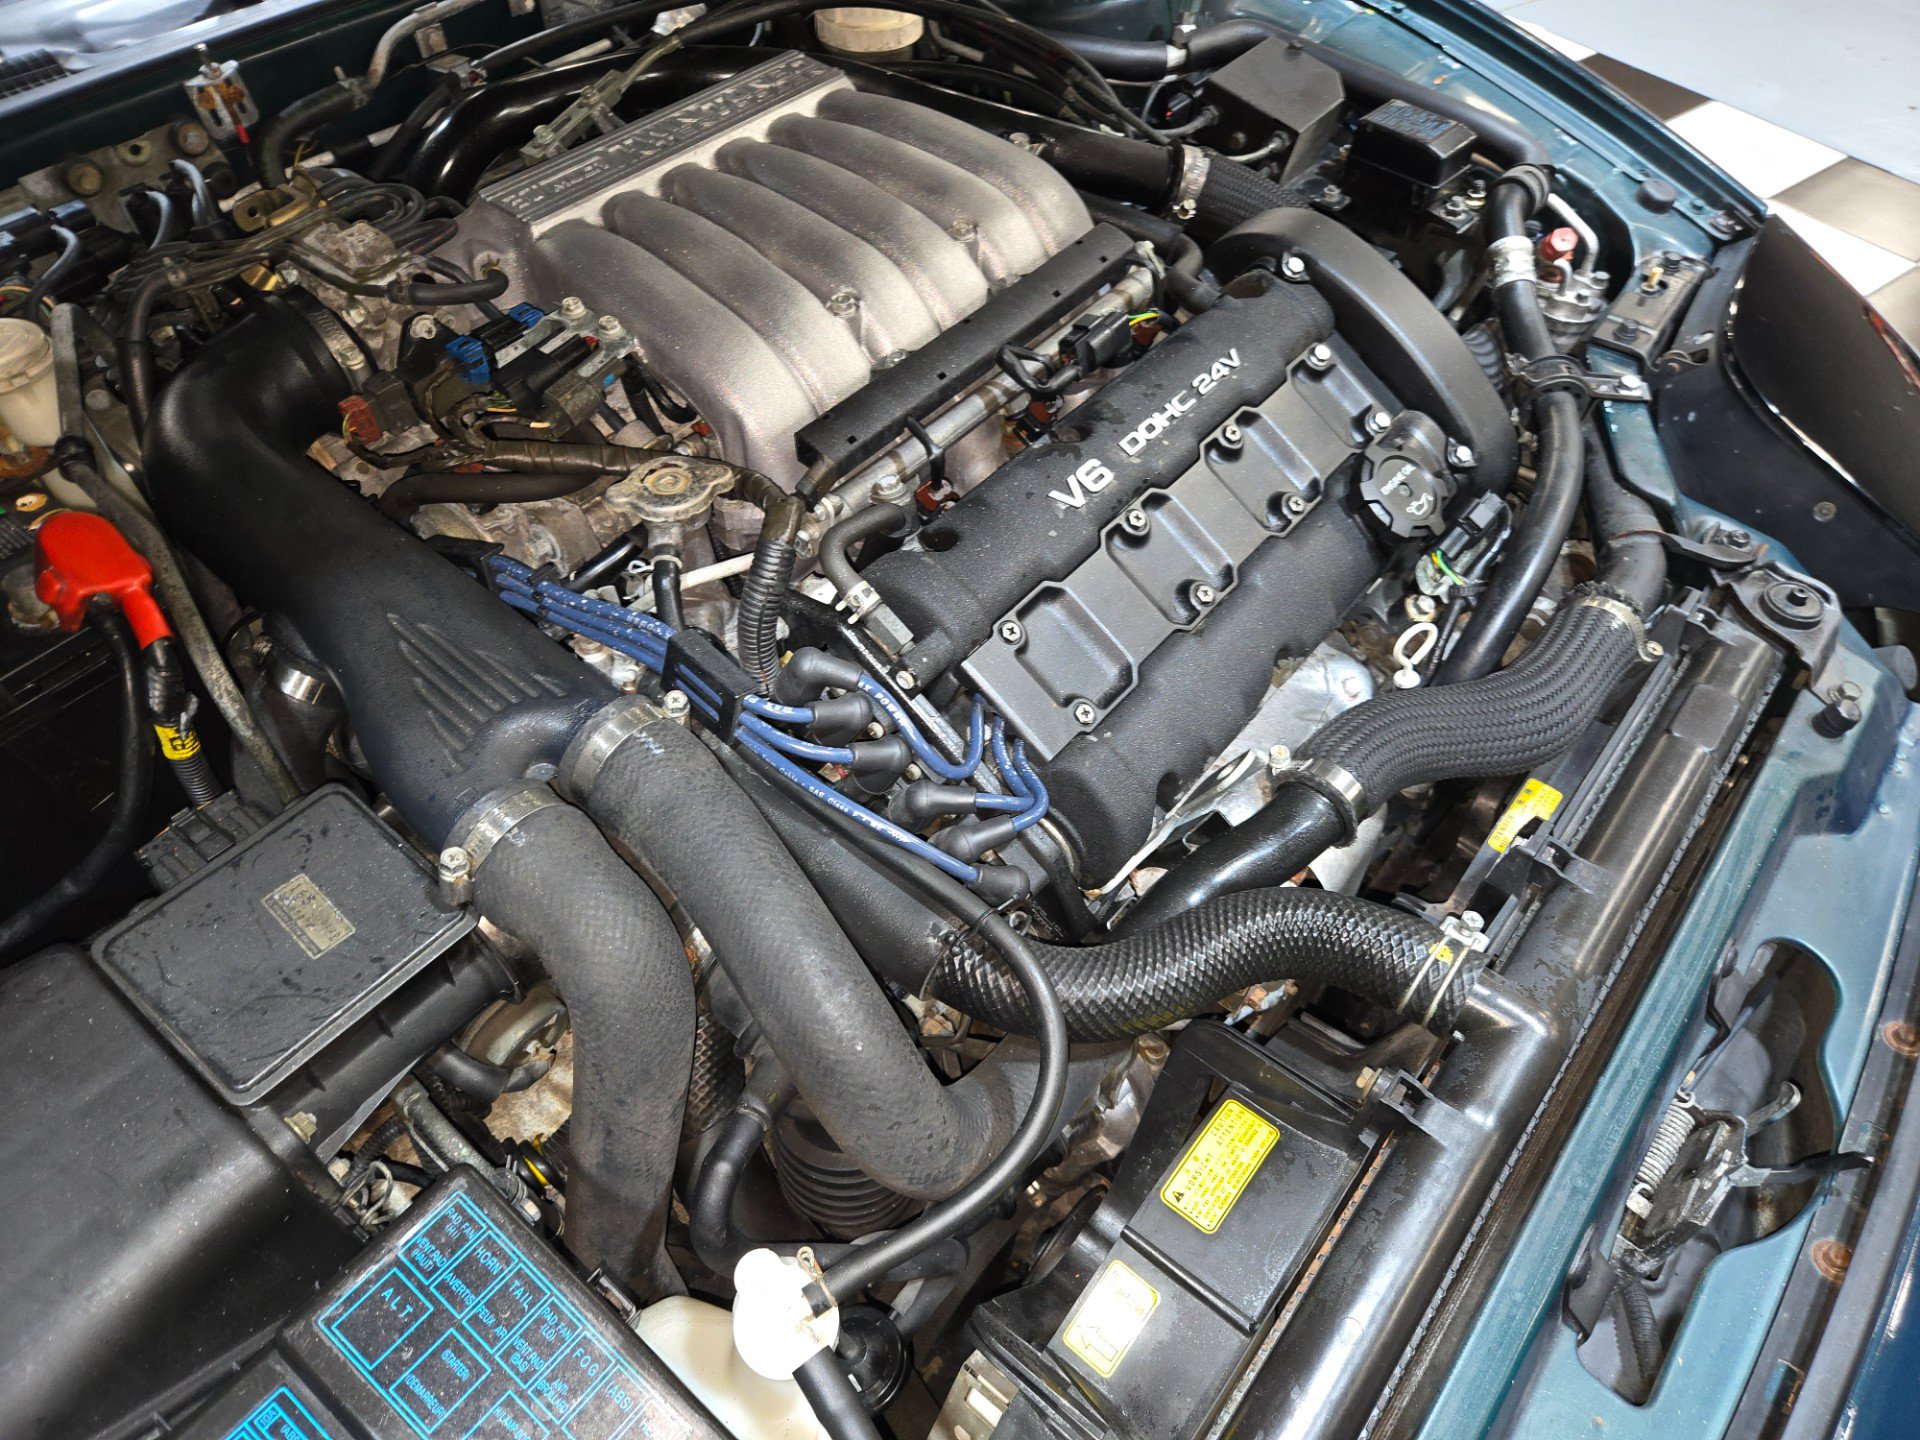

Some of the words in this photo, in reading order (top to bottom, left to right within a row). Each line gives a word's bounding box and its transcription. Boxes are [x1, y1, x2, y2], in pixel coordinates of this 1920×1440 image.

[1048, 459, 1115, 508] V6
[1119, 390, 1196, 456] DOHC
[1192, 348, 1240, 396] 24V
[1379, 469, 1406, 497] ENGINE
[1210, 1107, 1233, 1136] CAUTION
[458, 1221, 477, 1240] FAN
[410, 1247, 434, 1271] (HAUT)
[473, 1245, 503, 1275] HORN
[442, 1271, 476, 1305] AVERTIS
[507, 1279, 536, 1308] TAIL
[474, 1303, 497, 1327] FEUX
[492, 1323, 509, 1340] AR
[538, 1322, 558, 1342] (LO)
[555, 1321, 574, 1340] FAN
[507, 1350, 530, 1374] (BAS)
[571, 1347, 600, 1376] FOG
[603, 1380, 635, 1412] (ABS)
